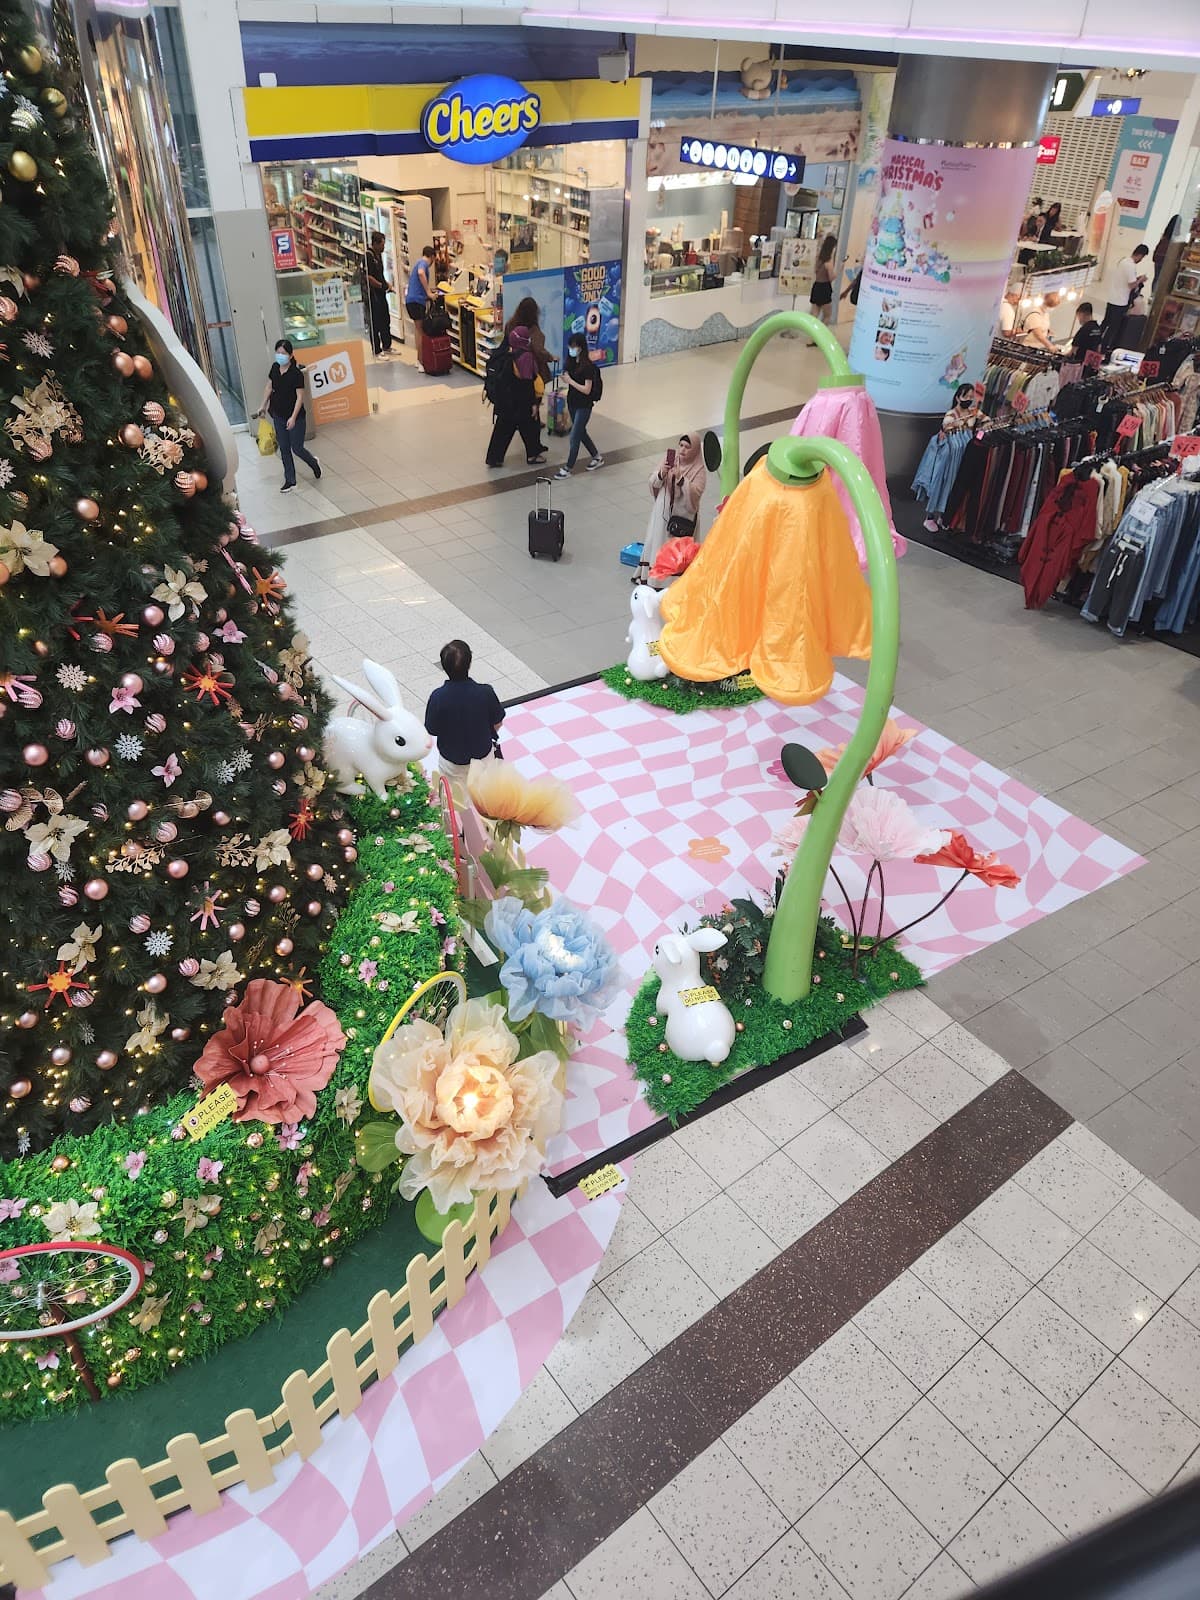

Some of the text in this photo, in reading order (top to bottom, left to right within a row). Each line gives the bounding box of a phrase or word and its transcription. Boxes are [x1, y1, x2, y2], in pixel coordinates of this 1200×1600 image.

[427, 96, 539, 145] Cheers
[581, 265, 606, 282] GOOD
[581, 280, 605, 292] ENERGY
[583, 289, 603, 303] ONLY
[198, 1090, 232, 1119] PLEASE
[193, 1124, 203, 1135] DO
[203, 1114, 217, 1127] NOT
[590, 1168, 616, 1184] PLEASE
